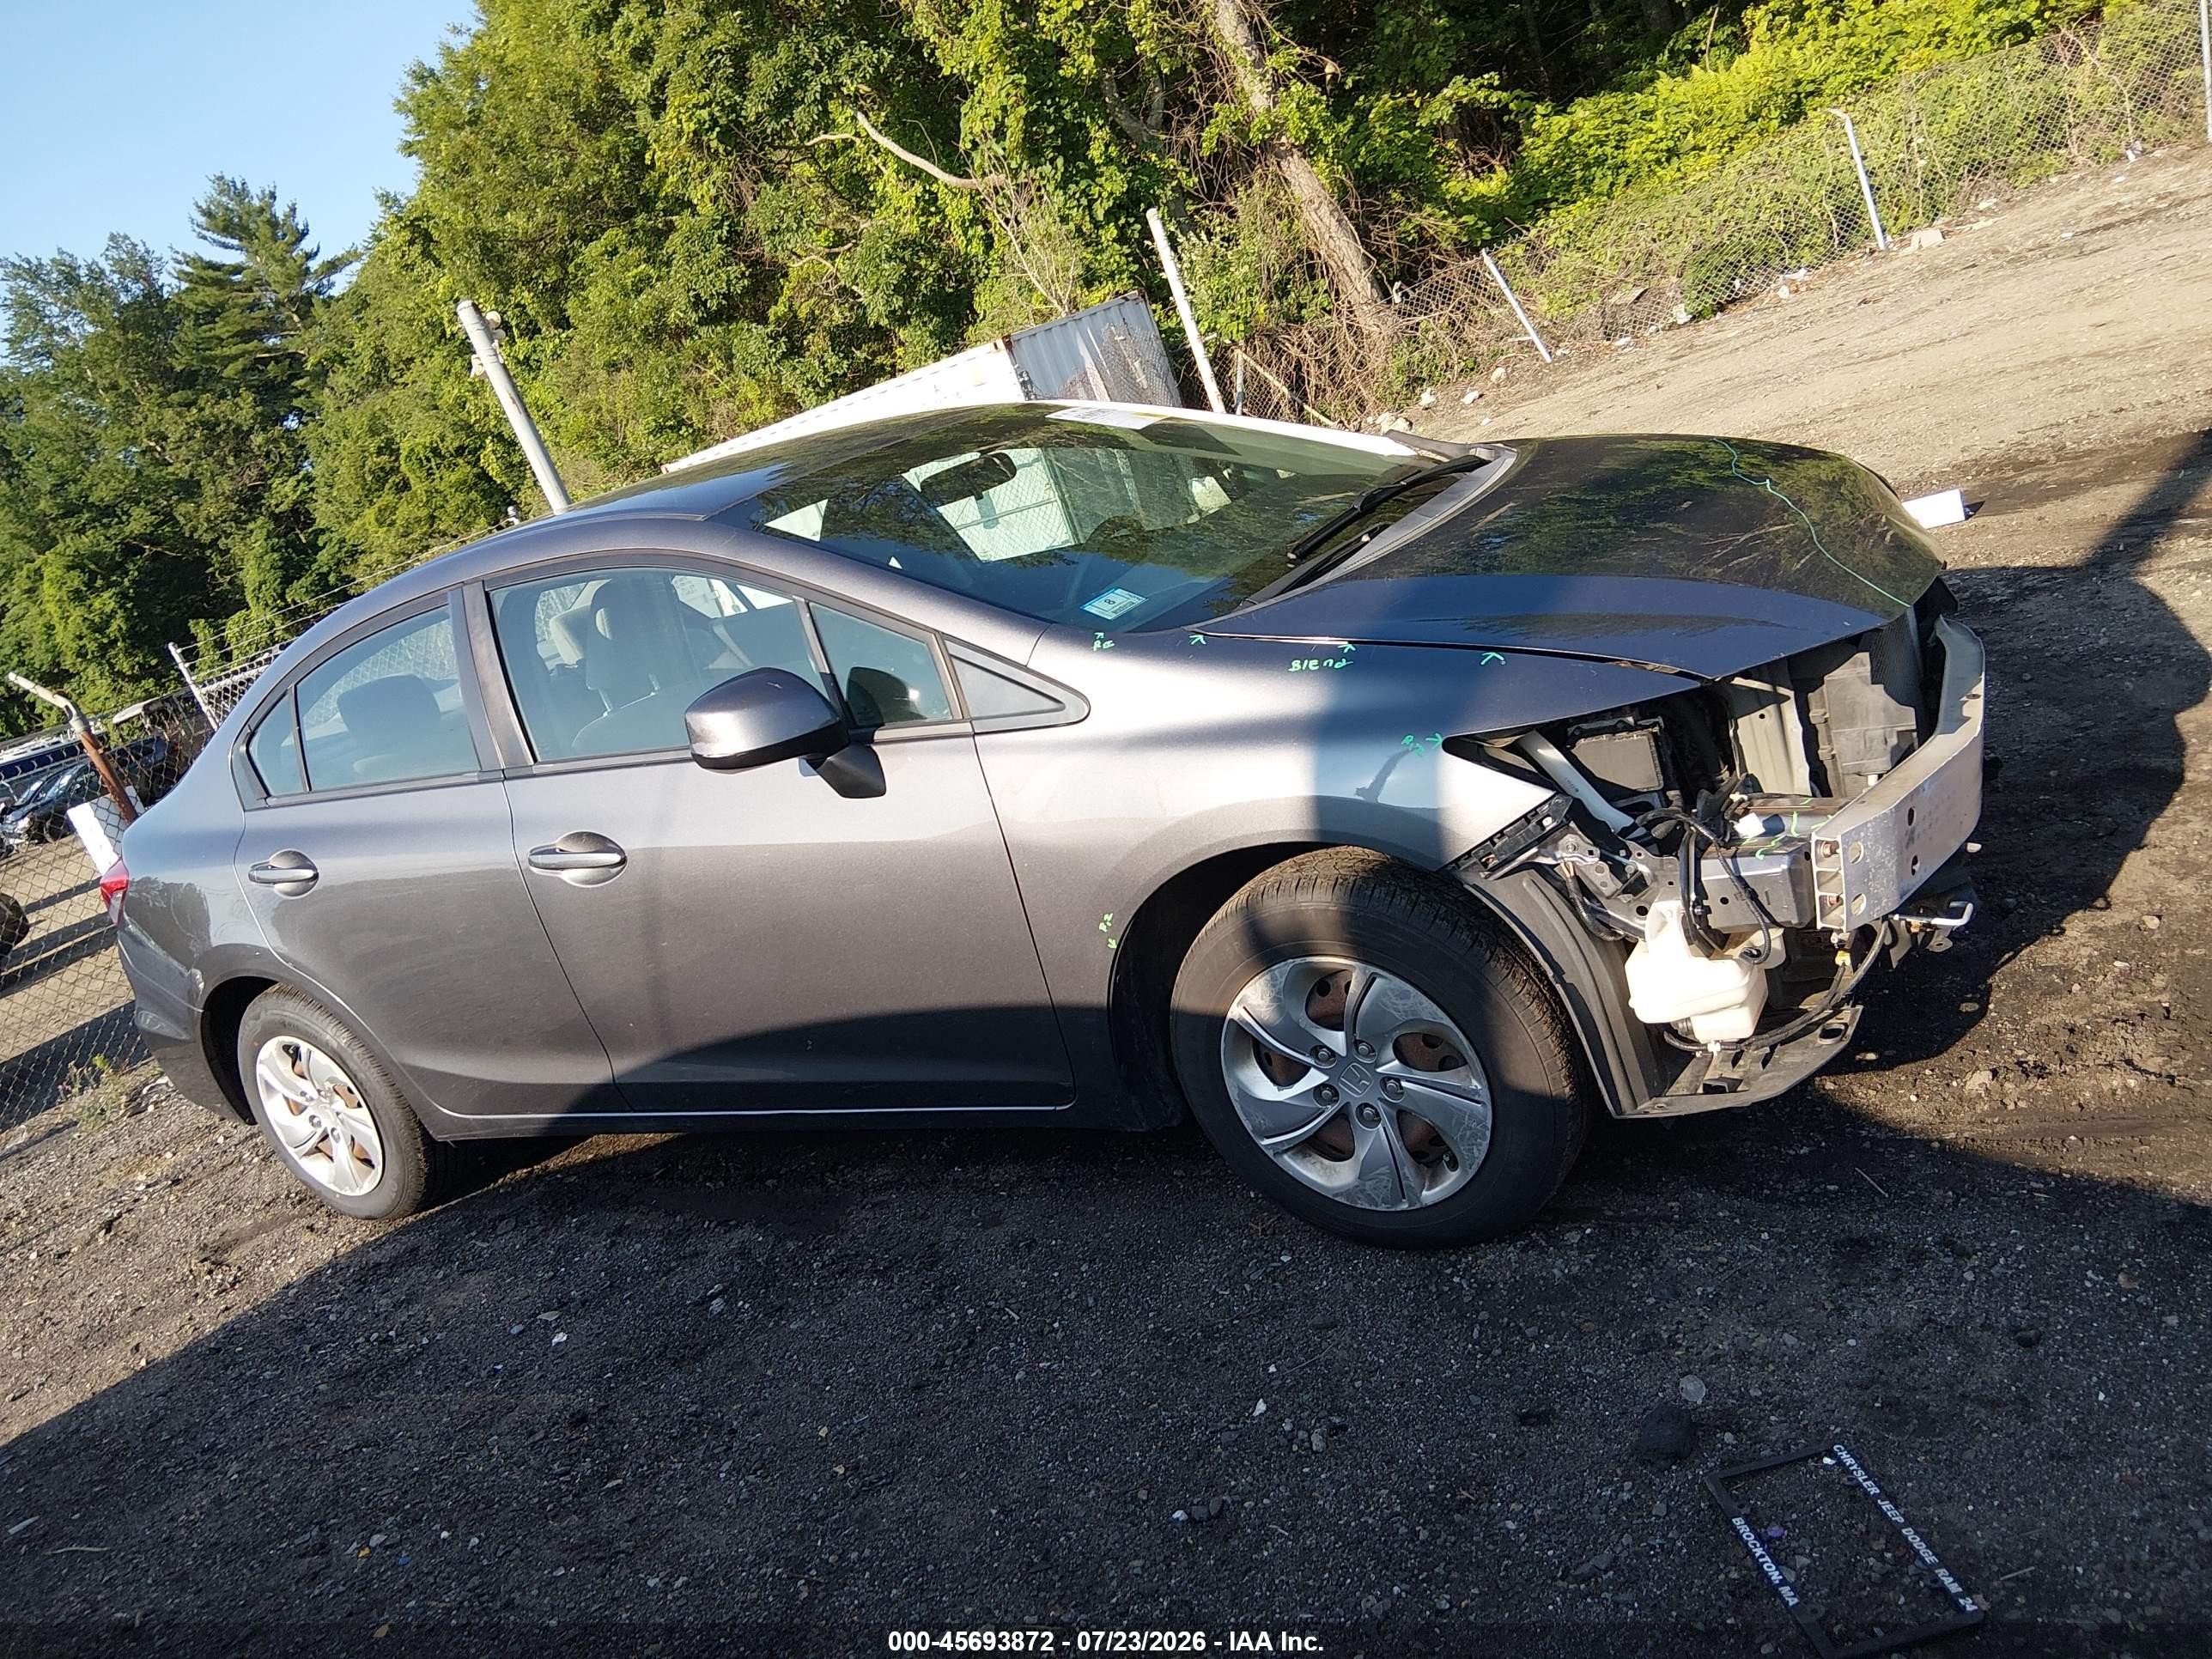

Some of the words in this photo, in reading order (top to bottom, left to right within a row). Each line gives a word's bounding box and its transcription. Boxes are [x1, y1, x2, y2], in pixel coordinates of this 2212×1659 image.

[1730, 1516, 1784, 1585] BROCKTON,
[1778, 1585, 1802, 1607] MA
[1832, 1443, 1881, 1497] CHRYSLER
[1876, 1498, 1905, 1525] JEEP
[1900, 1526, 1940, 1566] DODGE
[1933, 1567, 1964, 1595] RAM
[1957, 1595, 1979, 1613] 24
